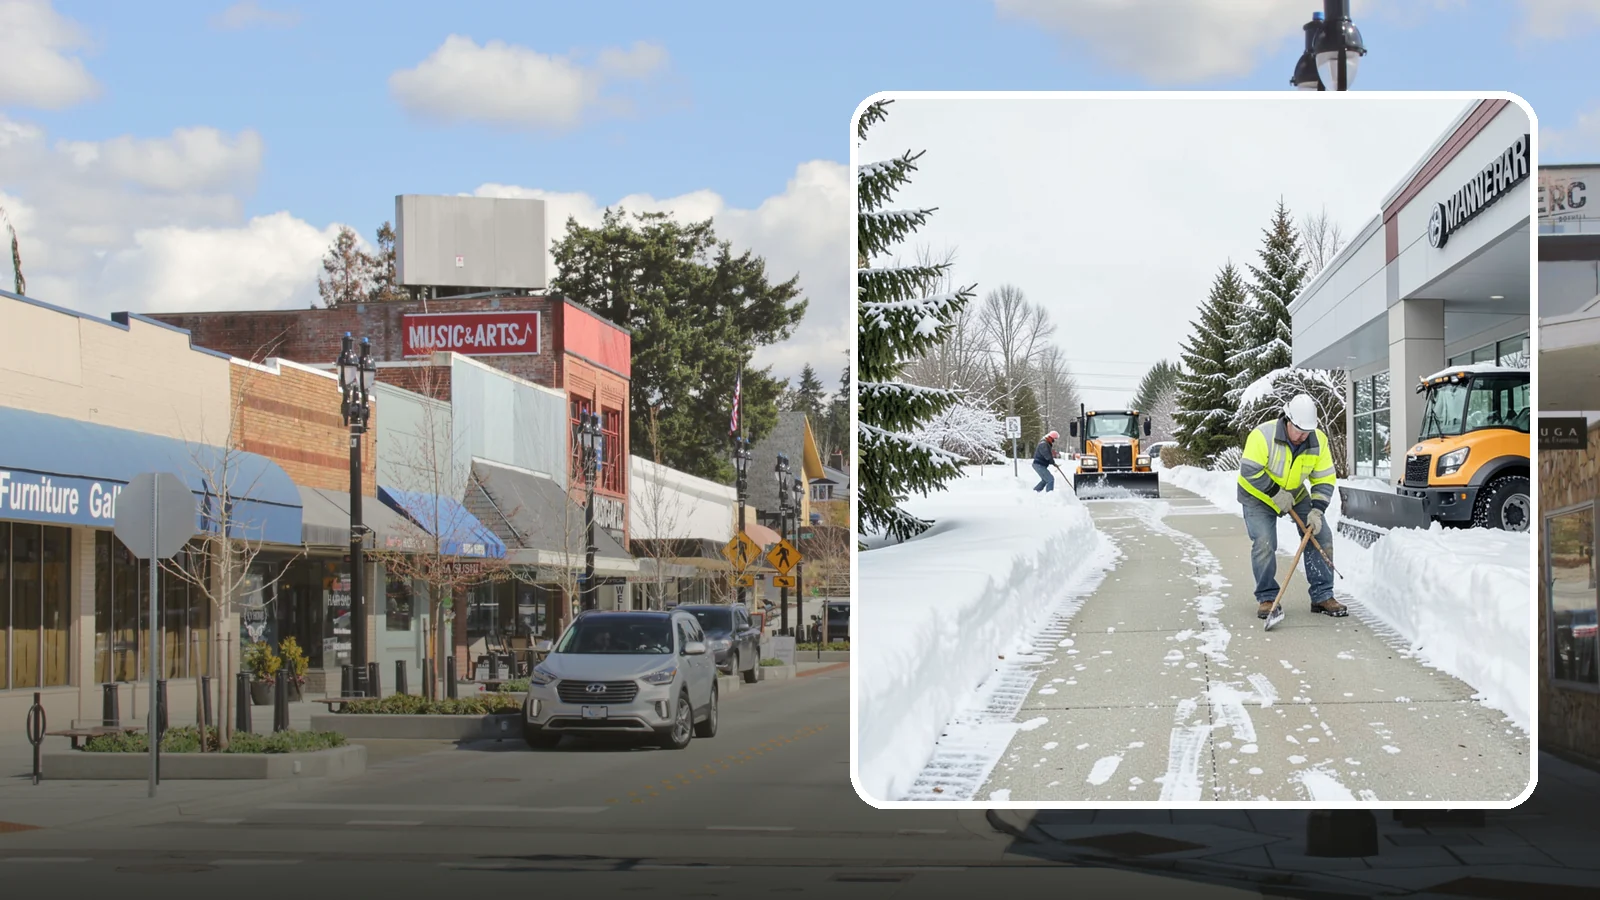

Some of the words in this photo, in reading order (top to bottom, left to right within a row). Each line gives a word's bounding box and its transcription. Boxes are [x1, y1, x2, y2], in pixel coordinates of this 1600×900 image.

[409, 323, 519, 349] MUSIC&ARTS
[1540, 427, 1578, 437] UGA
[0, 471, 80, 516] Furniture
[453, 563, 480, 574] SUSHI
